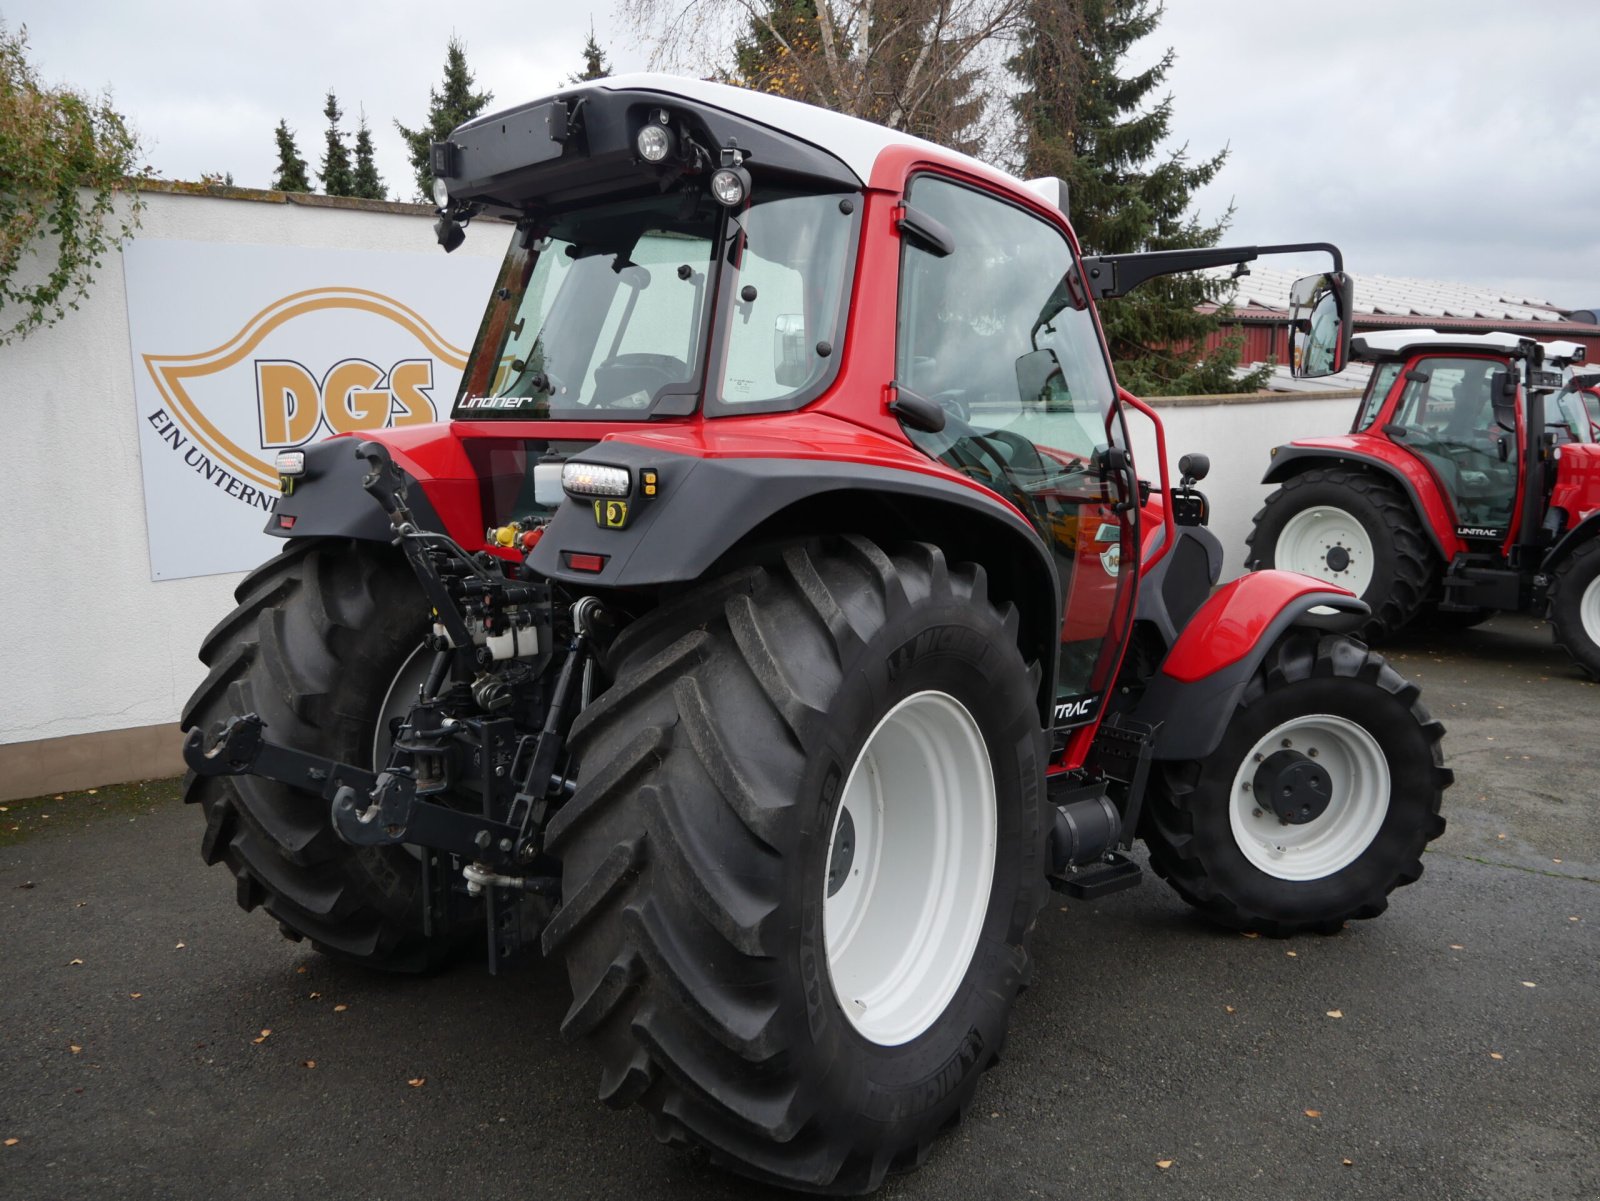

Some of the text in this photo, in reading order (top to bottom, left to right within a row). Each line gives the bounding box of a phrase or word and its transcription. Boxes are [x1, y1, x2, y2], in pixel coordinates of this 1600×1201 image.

[254, 358, 438, 449] DGS
[457, 391, 533, 409] Lindner
[147, 408, 188, 451] EIN
[1054, 698, 1092, 719] TRAC
